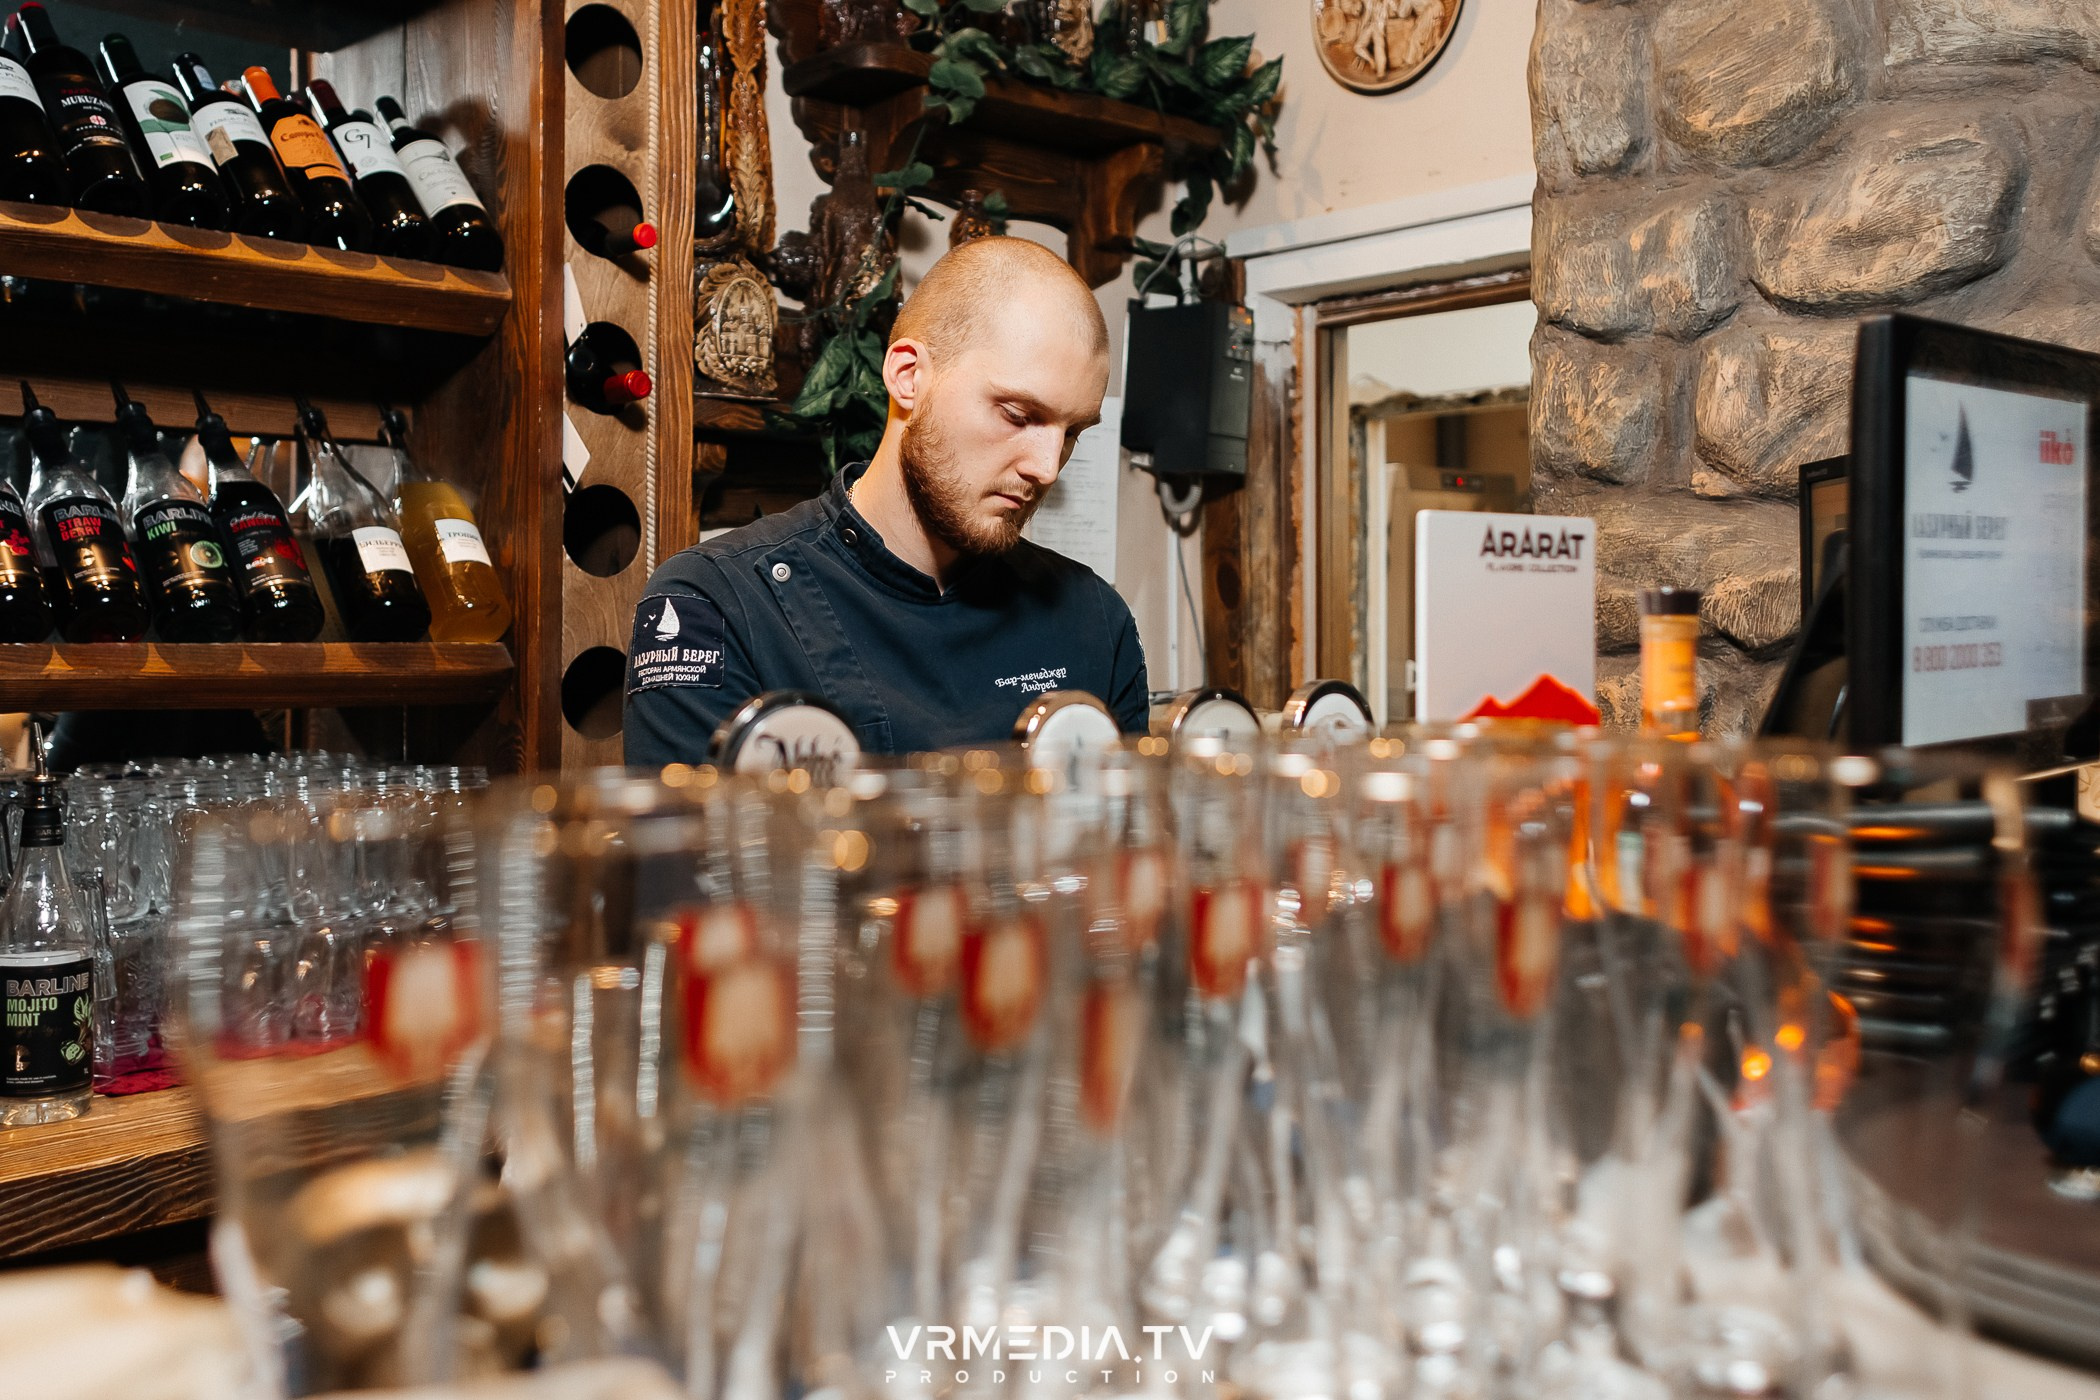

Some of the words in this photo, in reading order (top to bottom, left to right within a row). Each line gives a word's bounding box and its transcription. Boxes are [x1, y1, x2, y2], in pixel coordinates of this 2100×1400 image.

[54, 504, 120, 525] BARLI
[58, 517, 101, 532] STRAW
[146, 521, 177, 541] KIWI
[61, 526, 101, 541] BERRY
[1480, 523, 1584, 559] ARARAT
[682, 648, 720, 664] БЕРЕГ
[662, 665, 707, 674] АРМЯНСКОЙ
[995, 667, 1067, 688] Бар-менеджер
[642, 673, 674, 686] ДОМАШНЕЙ
[675, 673, 700, 682] КУХНИ
[1021, 679, 1058, 693] Андрей
[6, 972, 90, 997] BARLINE
[6, 997, 58, 1013] MOJITO
[6, 1013, 40, 1027] MINT
